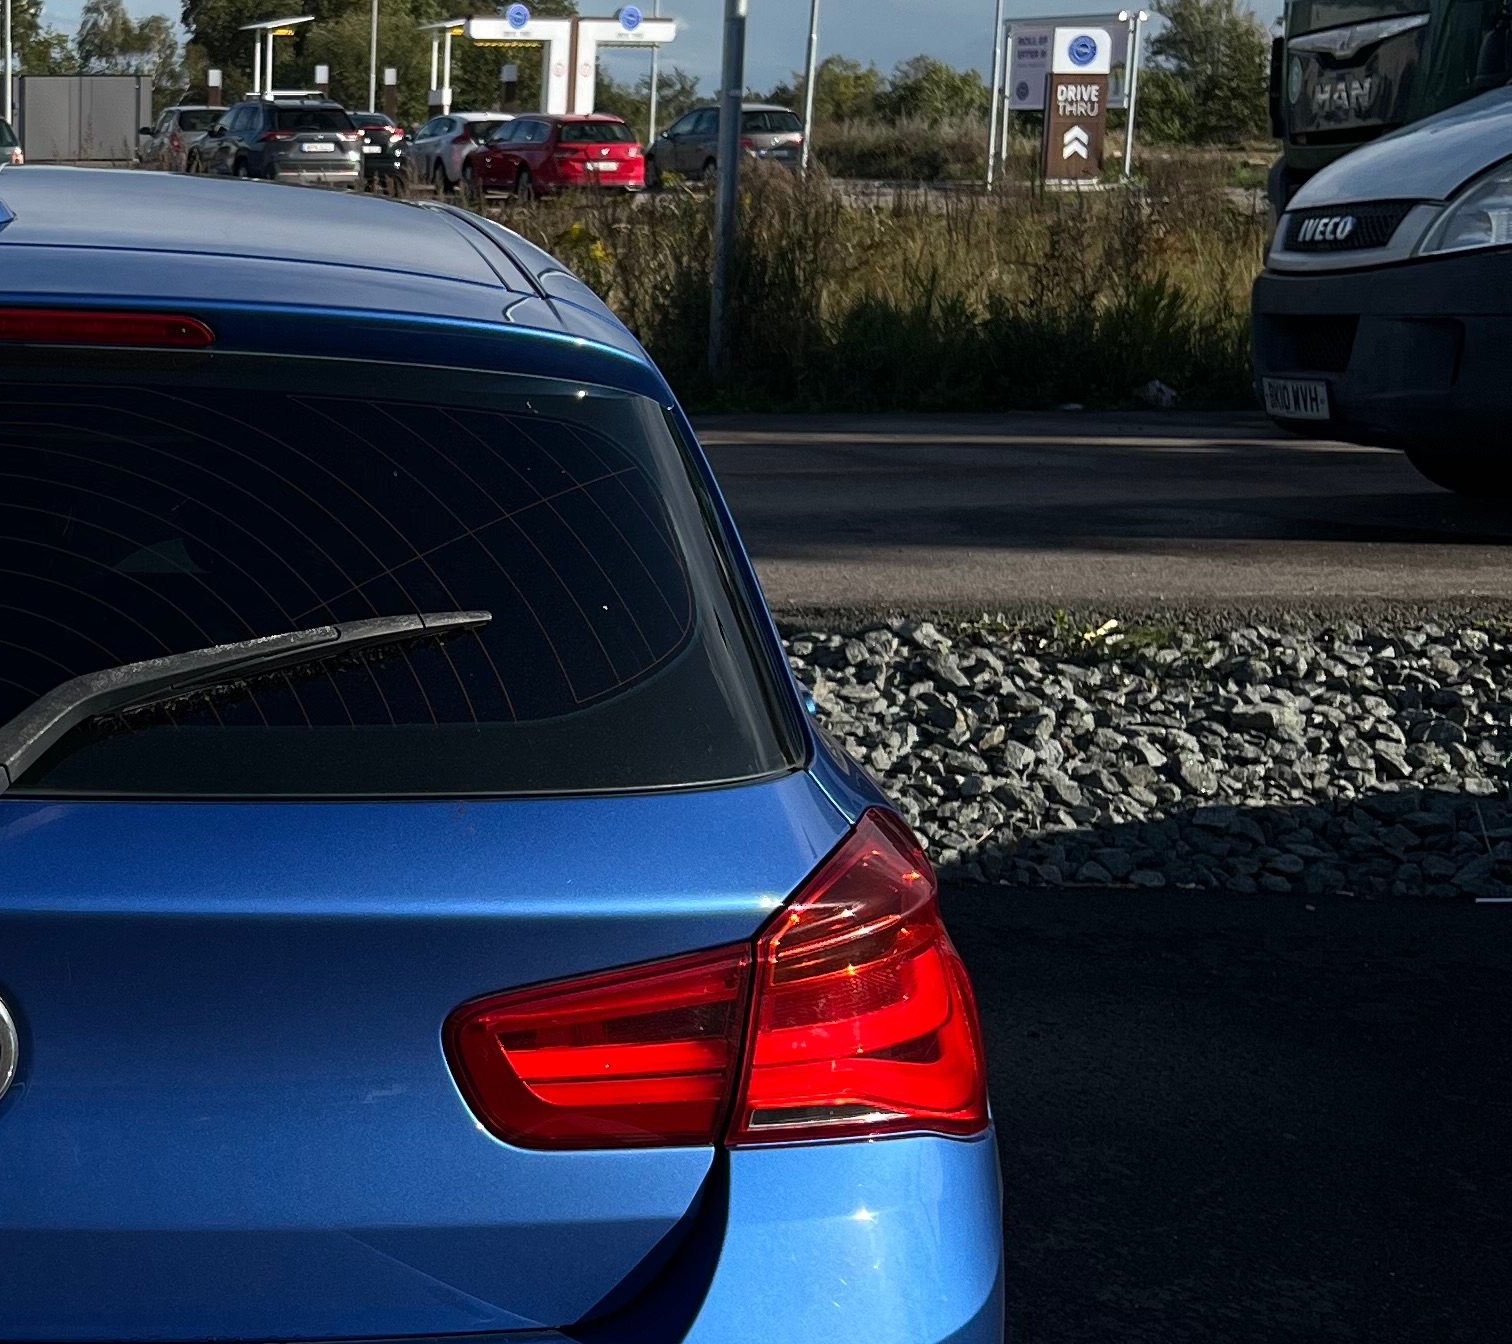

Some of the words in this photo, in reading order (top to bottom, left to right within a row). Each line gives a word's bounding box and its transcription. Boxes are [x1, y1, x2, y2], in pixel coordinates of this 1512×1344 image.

[1057, 84, 1100, 102] DRIVE
[1057, 101, 1099, 117] THRU
[1297, 215, 1355, 242] IVECO
